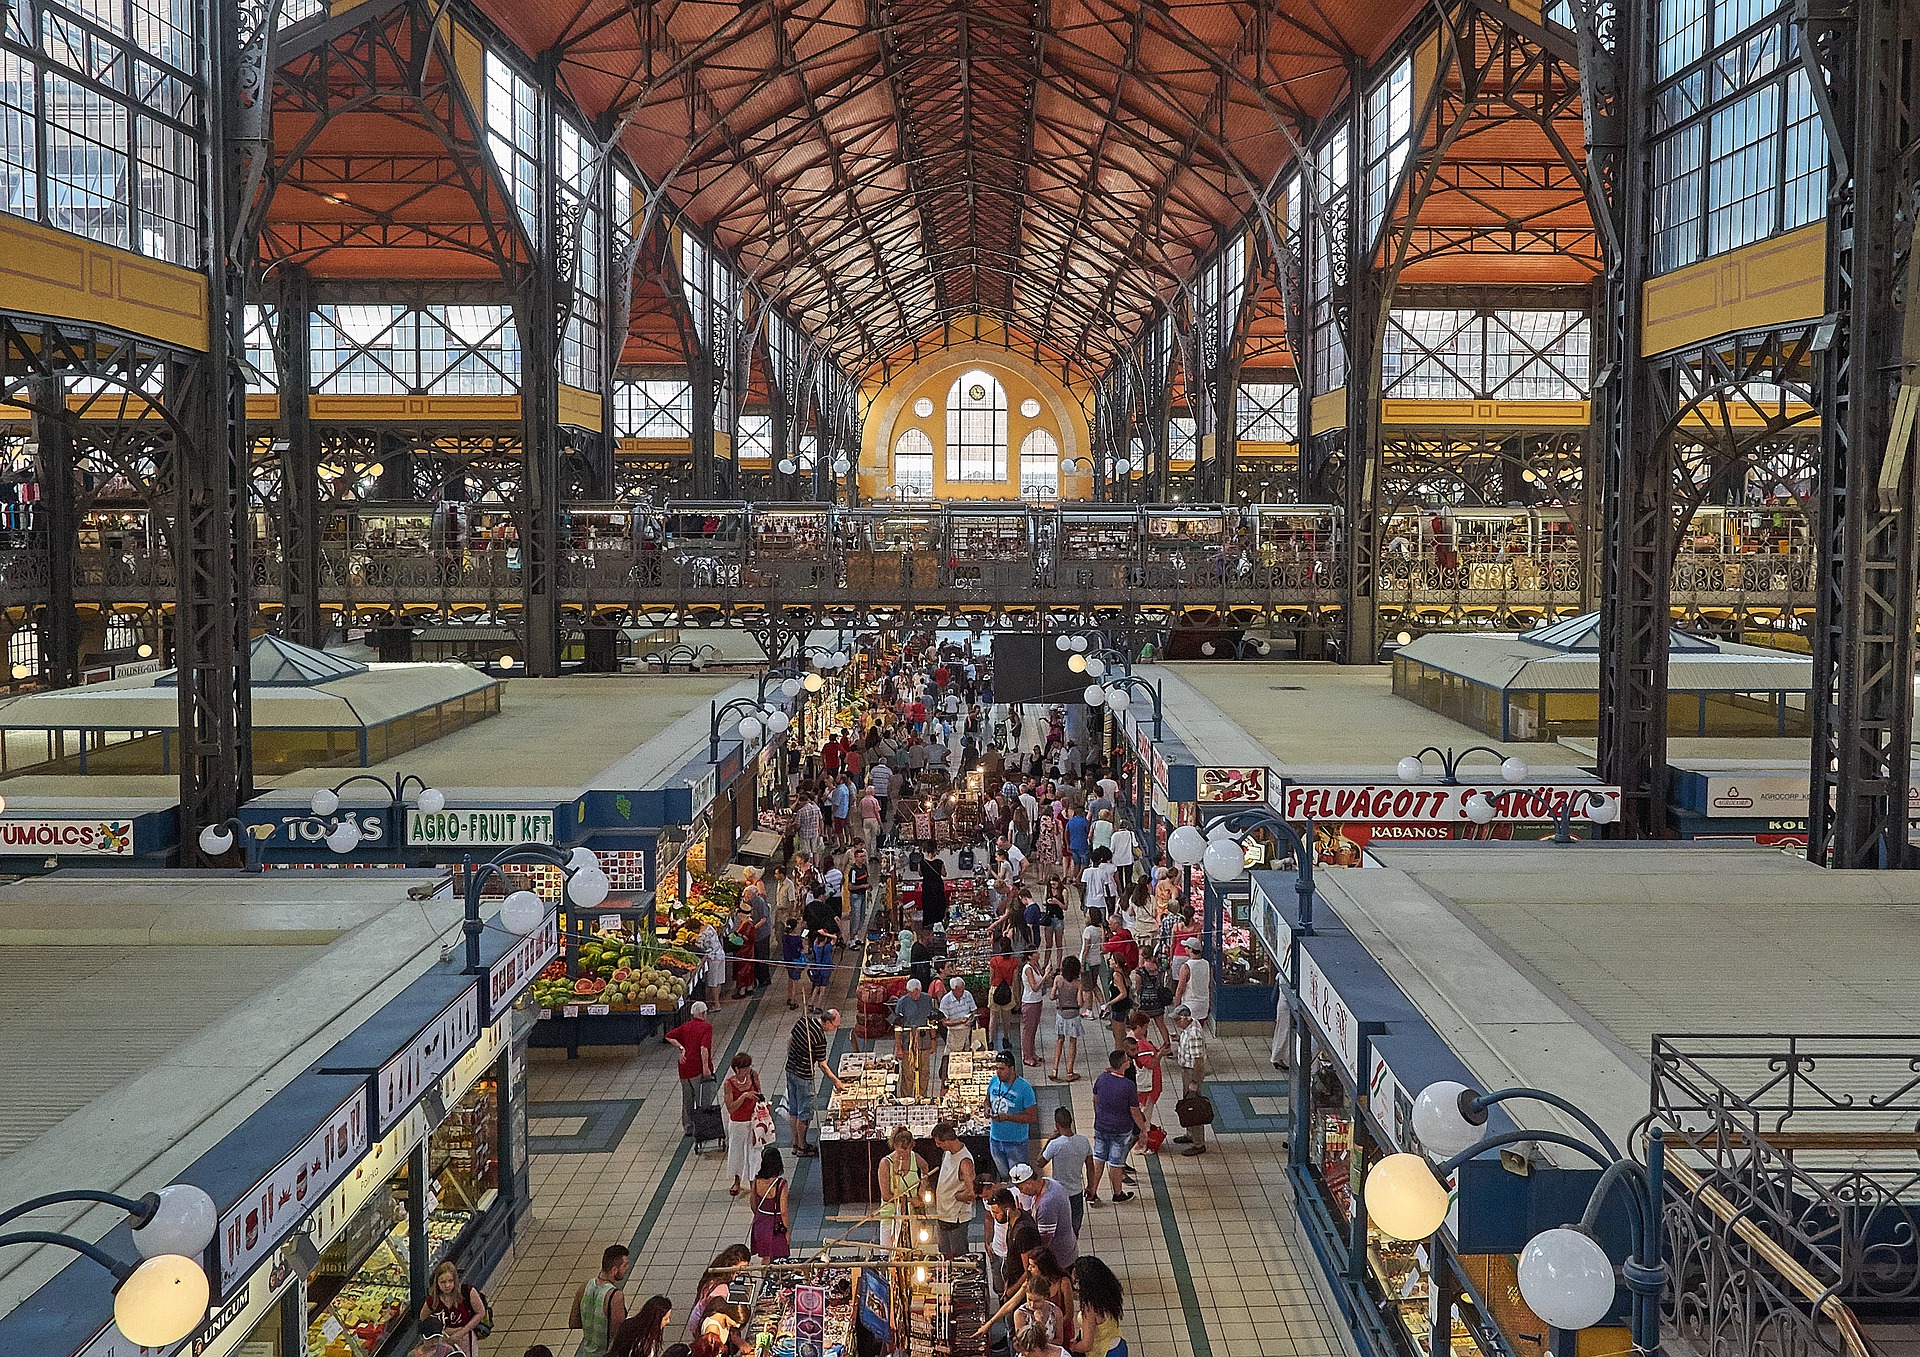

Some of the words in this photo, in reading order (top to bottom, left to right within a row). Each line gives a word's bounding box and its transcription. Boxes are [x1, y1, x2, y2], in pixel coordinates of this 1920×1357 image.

[1288, 786, 1449, 818] FELVÁGOTT
[0, 823, 93, 844] ÜMÖLCS
[412, 813, 516, 841] AGRO-FRUIT
[521, 815, 553, 842] KFT.
[1371, 827, 1448, 838] KABANOS
[203, 1290, 249, 1344] UNICUM
